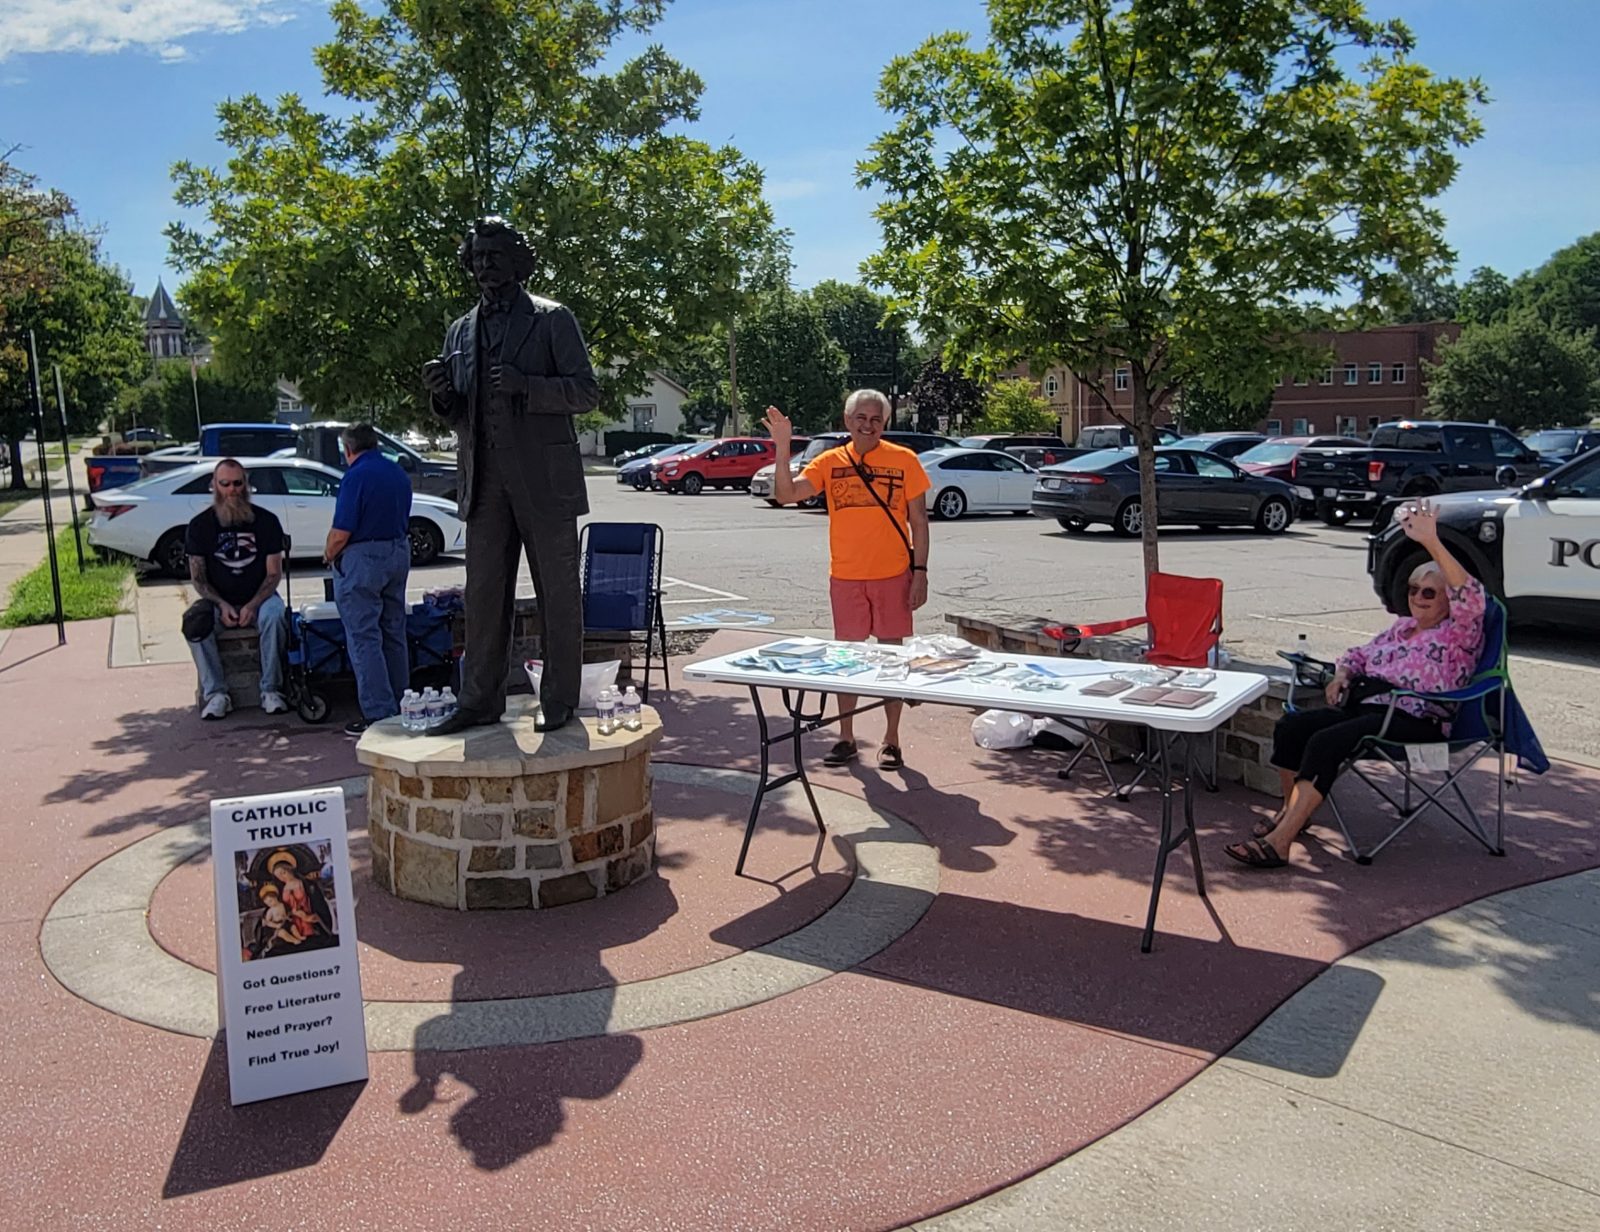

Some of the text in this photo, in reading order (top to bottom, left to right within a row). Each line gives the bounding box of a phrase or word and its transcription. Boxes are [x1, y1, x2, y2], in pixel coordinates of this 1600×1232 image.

[231, 800, 328, 823] CATHOLIC
[247, 822, 312, 841] TRUTH
[243, 965, 341, 990] Got Questions?
[245, 992, 341, 1015] Free Literature
[246, 1016, 332, 1040] Need Prayer?
[249, 1040, 339, 1067] Find True Joy!
